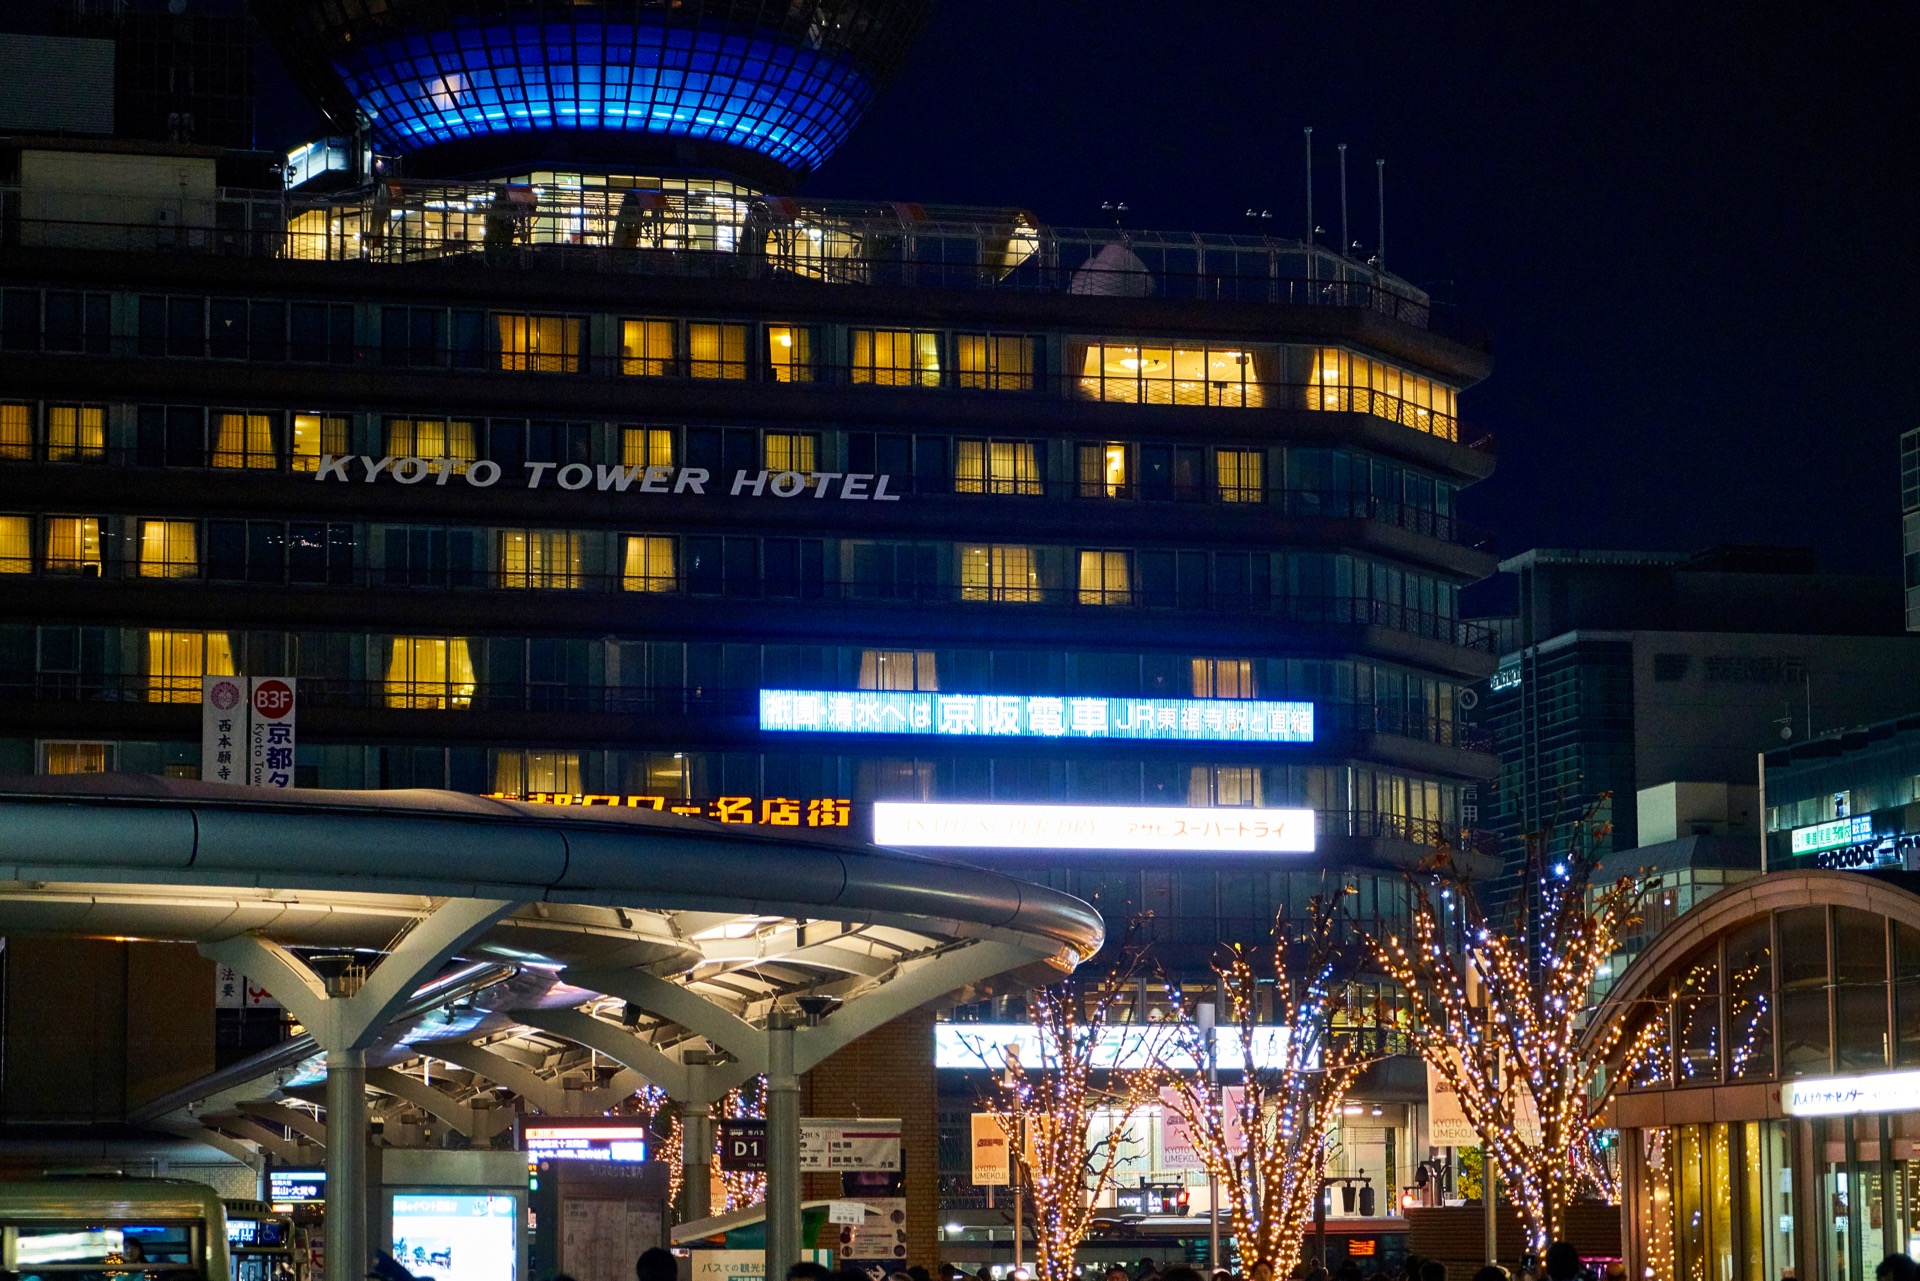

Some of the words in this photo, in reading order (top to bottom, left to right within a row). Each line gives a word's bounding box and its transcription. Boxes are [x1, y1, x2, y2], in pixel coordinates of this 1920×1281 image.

[314, 455, 501, 488] KYOTO
[523, 461, 710, 494] TOWER
[730, 470, 901, 501] HOTEL
[257, 691, 290, 708] B3F
[941, 695, 1107, 738] 京阪電車
[217, 719, 232, 780] 西本願寺
[253, 724, 265, 757] Kyoto
[254, 761, 265, 787] Tow
[1433, 1120, 1462, 1128] KYOTO
[734, 1141, 758, 1157] D1
[1165, 1146, 1190, 1154] KYOTO
[974, 1172, 1007, 1180] UMEKOJI
